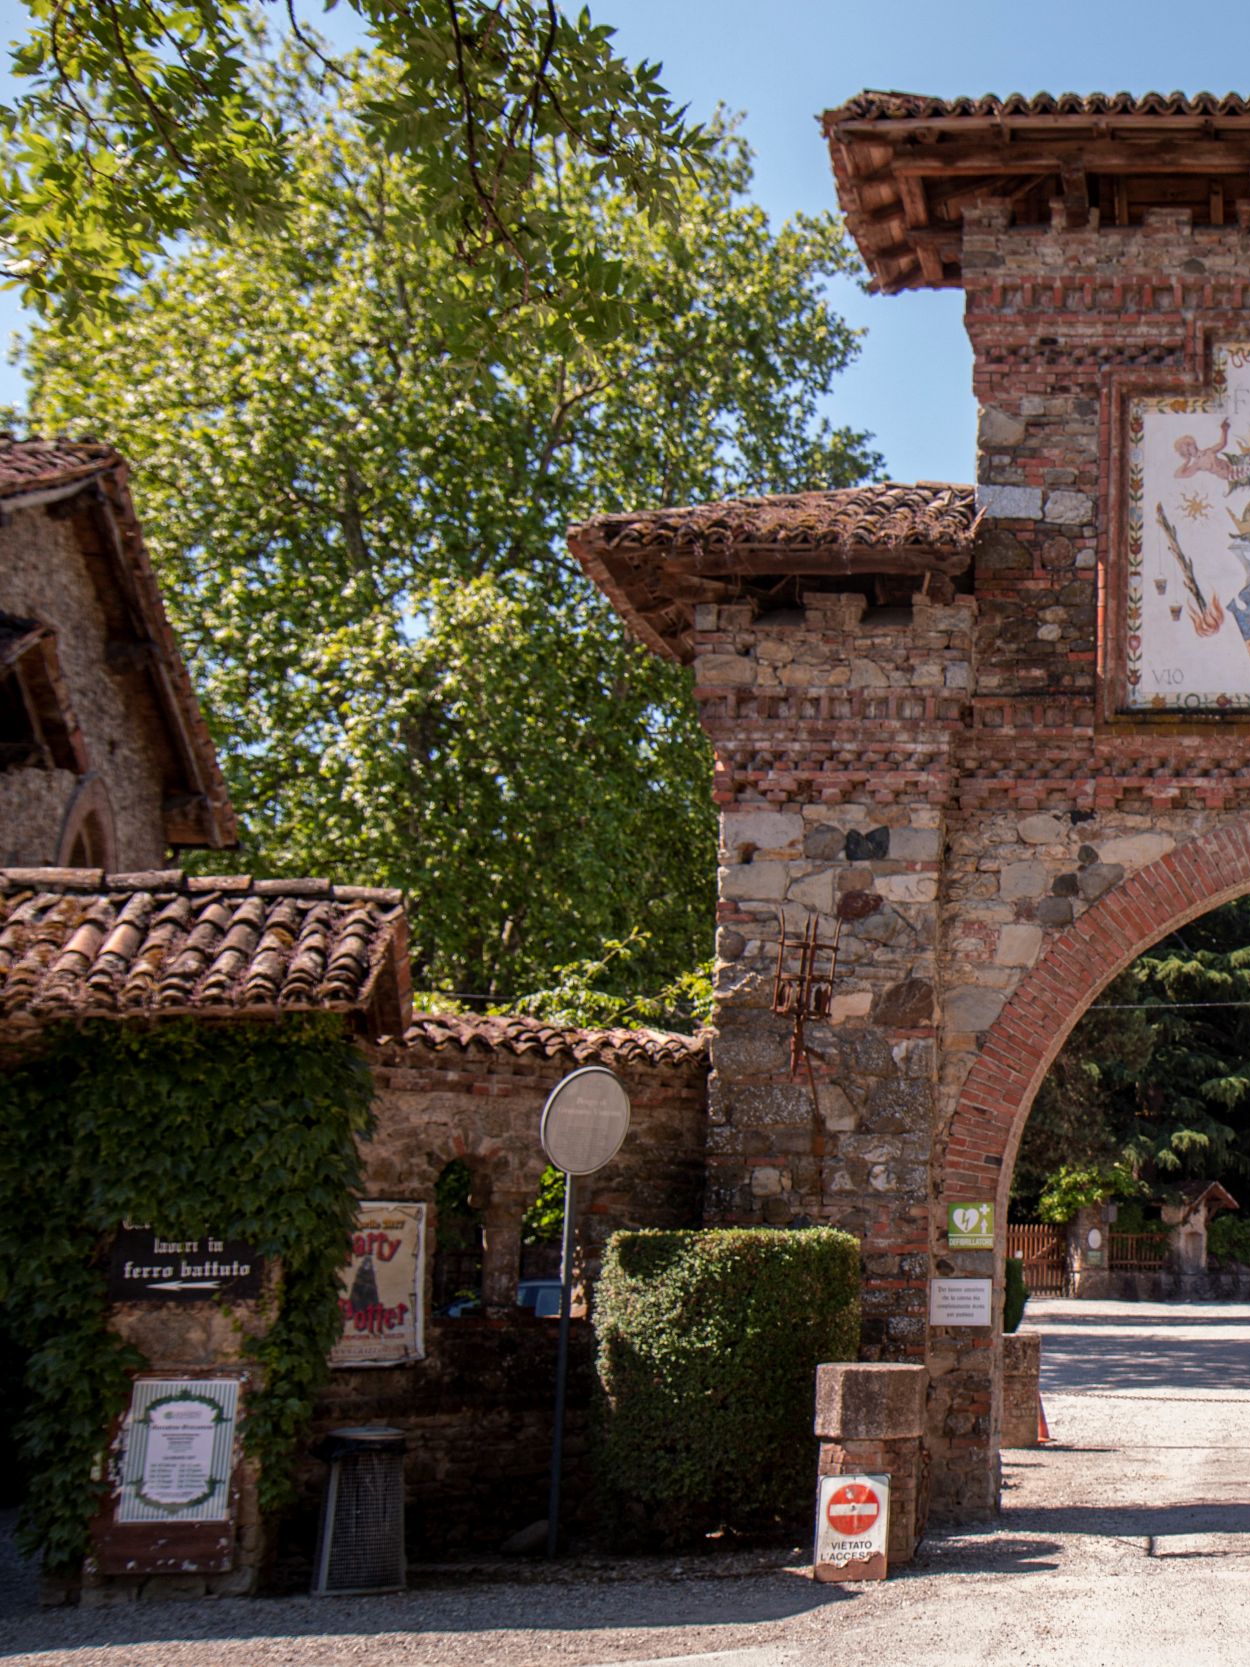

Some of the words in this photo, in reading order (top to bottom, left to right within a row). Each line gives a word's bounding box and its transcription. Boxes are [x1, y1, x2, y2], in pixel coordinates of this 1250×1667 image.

[208, 1236, 223, 1251] in
[346, 1231, 401, 1262] arry
[124, 1261, 173, 1278] ferro
[181, 1260, 250, 1277] battuto
[338, 1299, 408, 1334] Potter
[831, 1541, 873, 1551] VIETATO
